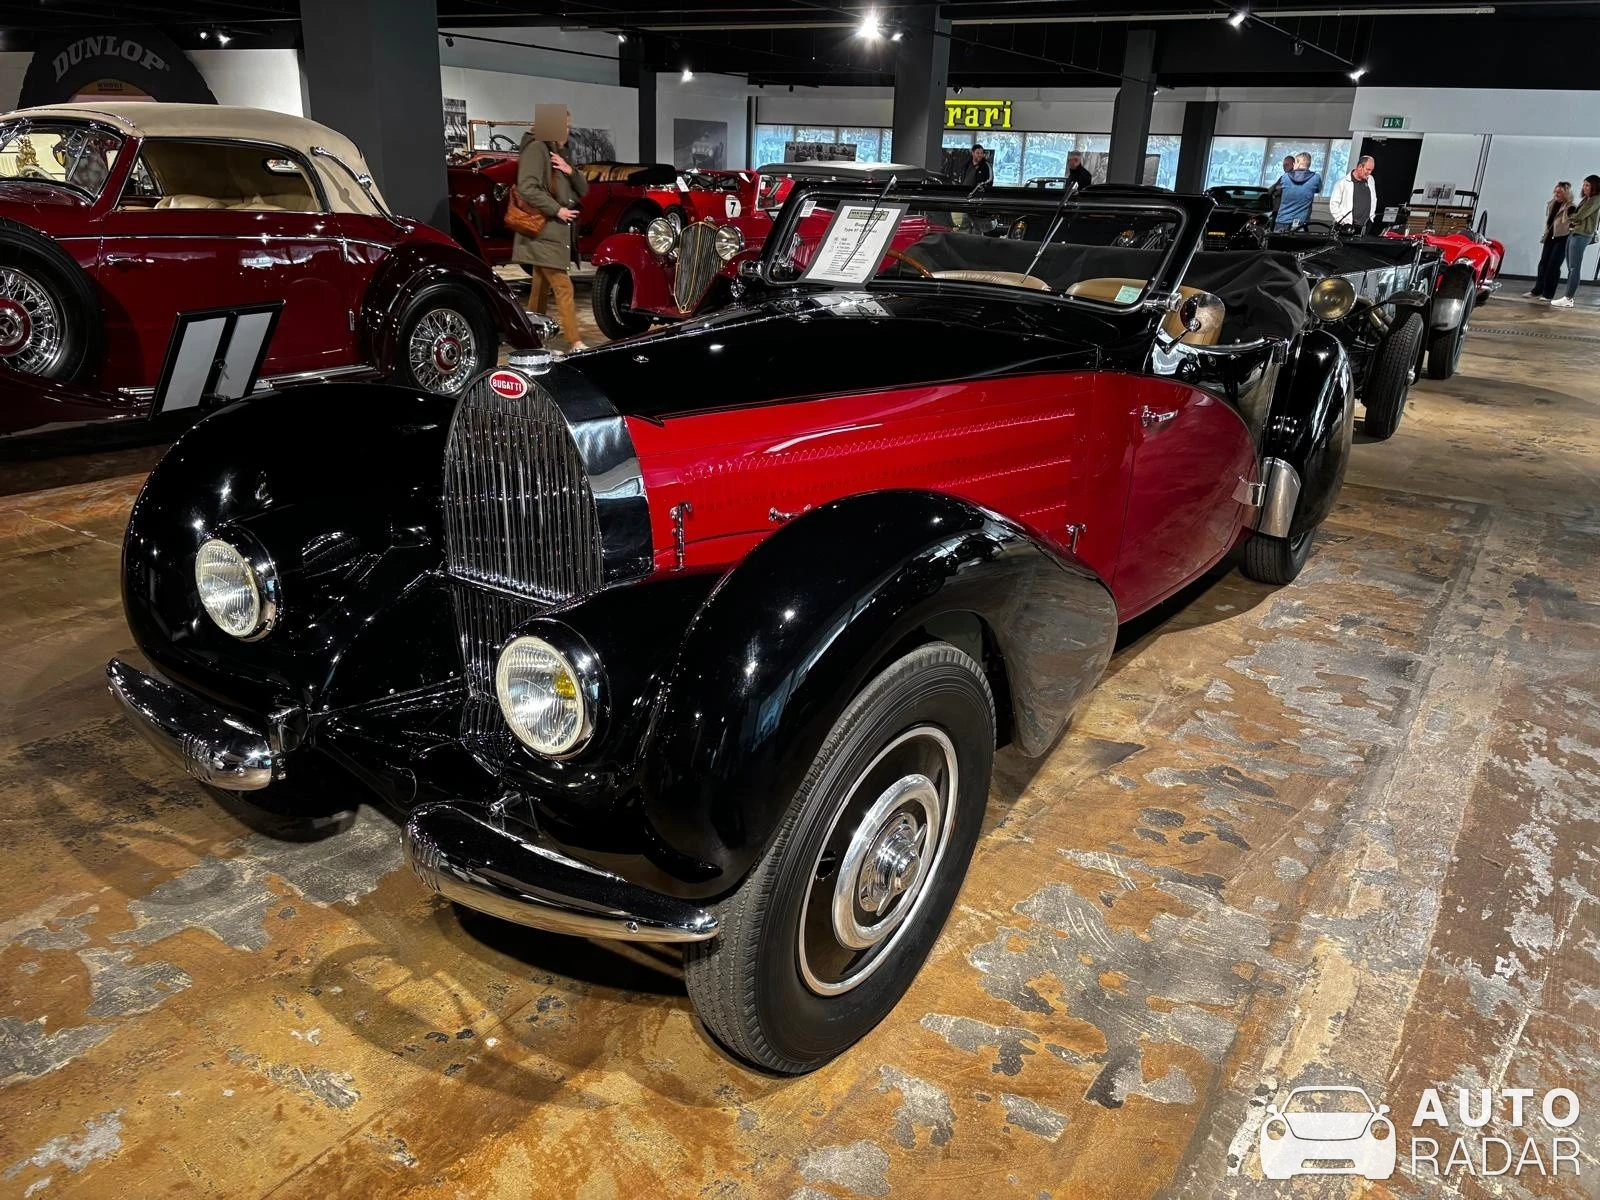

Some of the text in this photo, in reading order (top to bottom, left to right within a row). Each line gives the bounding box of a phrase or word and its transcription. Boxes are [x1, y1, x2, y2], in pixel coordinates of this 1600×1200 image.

[52, 35, 165, 83] DUNLOP
[944, 100, 1012, 128] rari
[730, 201, 737, 215] 7
[492, 379, 522, 391] BUGATTI
